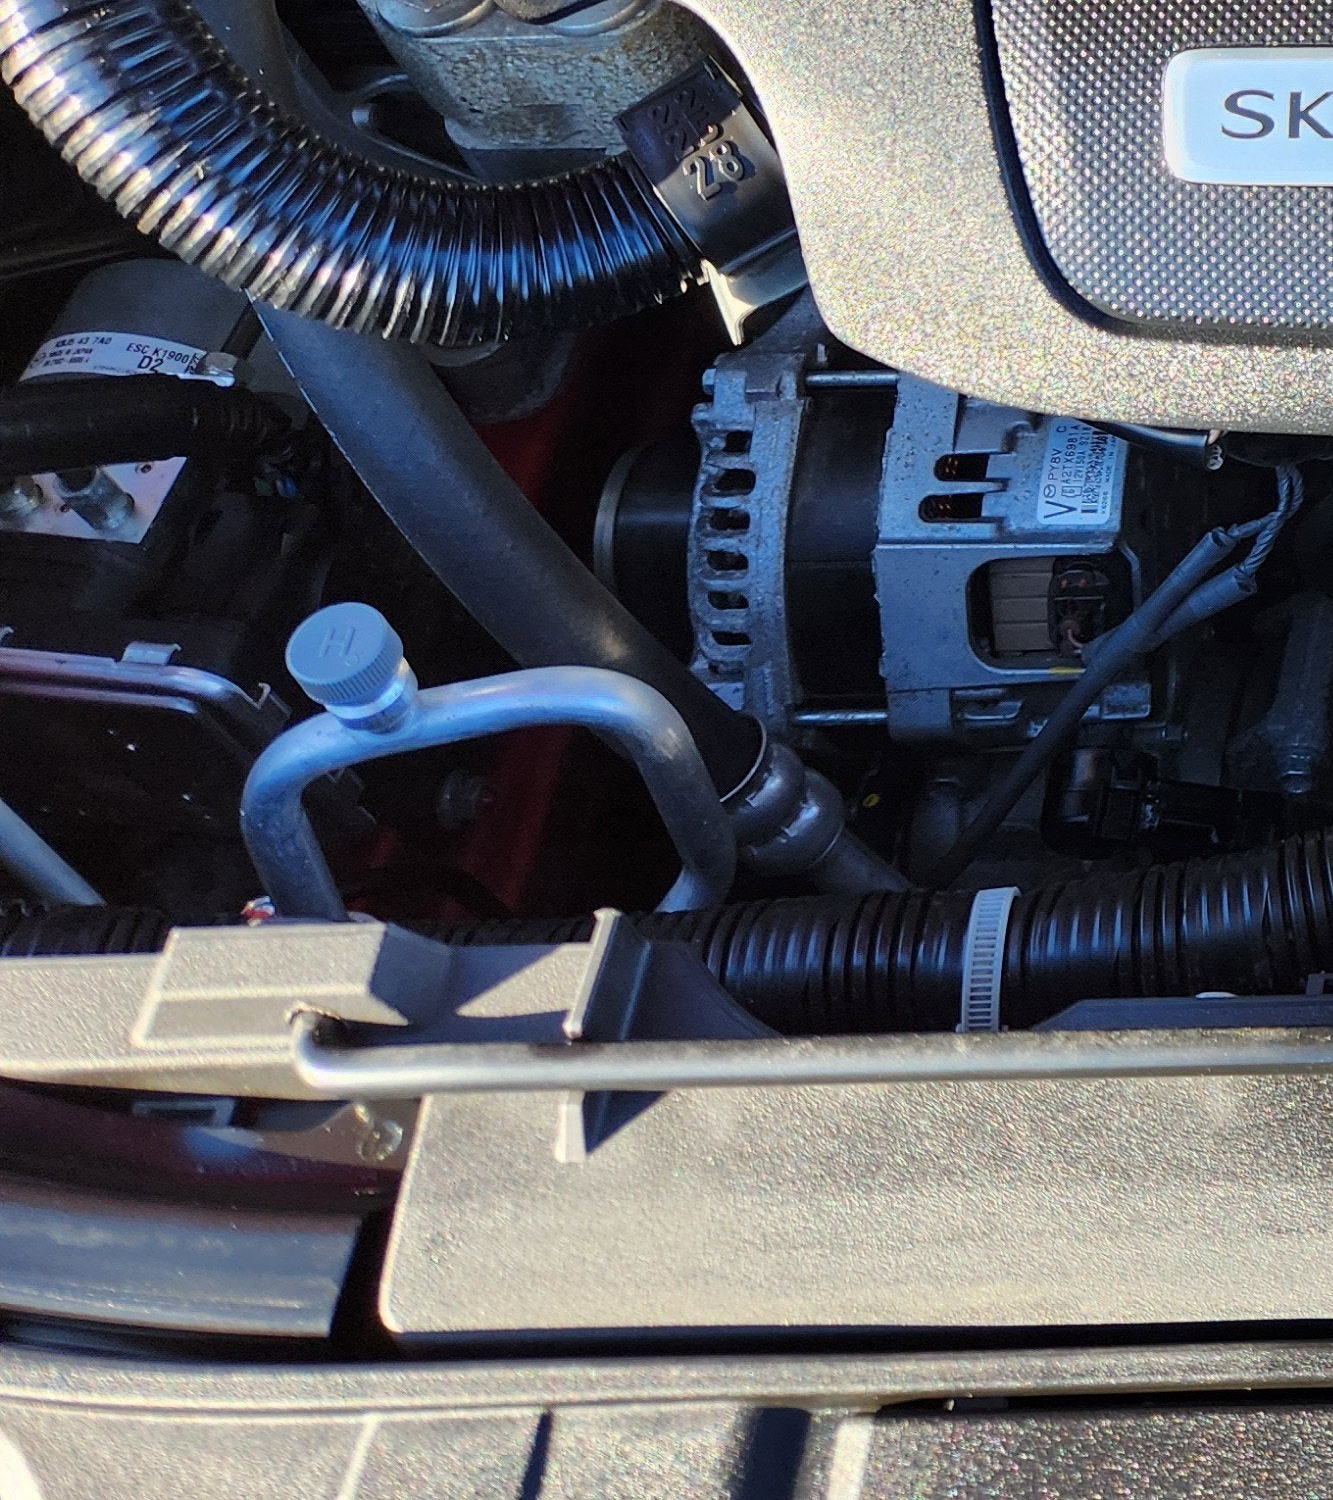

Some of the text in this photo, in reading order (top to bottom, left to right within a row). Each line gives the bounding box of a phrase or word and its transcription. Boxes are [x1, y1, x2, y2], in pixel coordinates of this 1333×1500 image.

[682, 140, 744, 201] 28
[126, 342, 149, 354] ESC
[152, 347, 189, 364] K1900
[137, 355, 165, 373] D2
[1047, 425, 1067, 481] PY8V C
[1061, 425, 1080, 484] A2TX6981A
[1043, 500, 1078, 519] V
[319, 627, 356, 658] H
